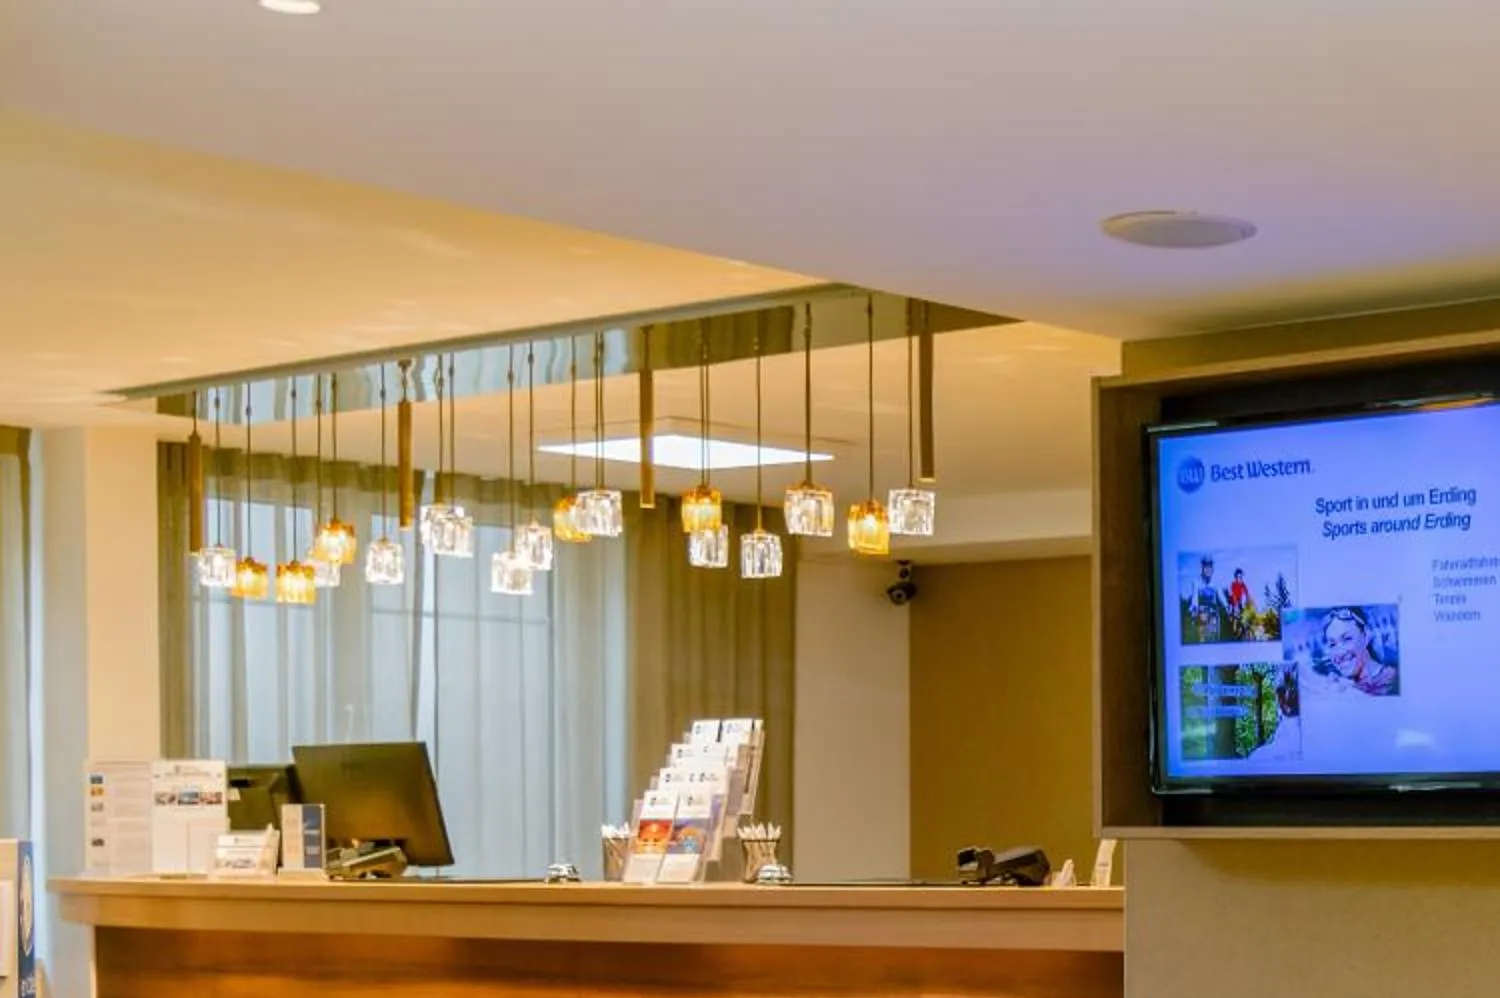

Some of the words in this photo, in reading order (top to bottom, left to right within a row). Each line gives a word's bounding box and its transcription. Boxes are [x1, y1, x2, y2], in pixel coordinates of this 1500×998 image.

[1210, 463, 1244, 482] Best
[1246, 459, 1311, 479] Western
[1315, 497, 1352, 516] Sport
[1355, 495, 1369, 511] in
[1371, 491, 1399, 509] und
[1403, 493, 1425, 507] um
[1429, 486, 1477, 506] Erding
[1321, 520, 1367, 540] Sports
[1370, 515, 1421, 534] around
[1424, 511, 1472, 531] Erding
